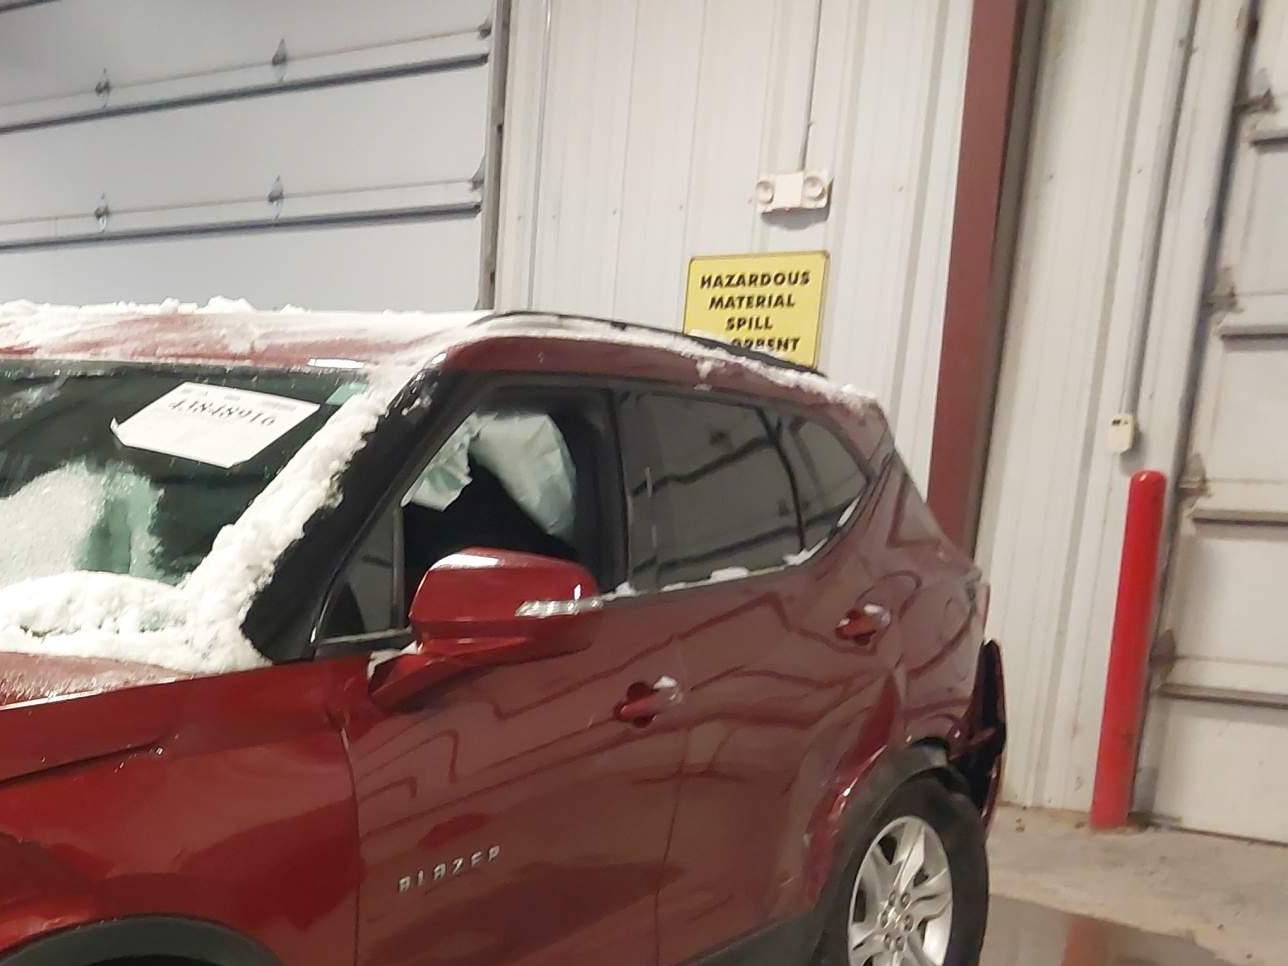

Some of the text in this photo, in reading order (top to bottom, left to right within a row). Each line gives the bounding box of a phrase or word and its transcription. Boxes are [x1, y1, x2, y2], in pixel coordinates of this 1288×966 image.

[700, 271, 811, 289] HAZARDOUS
[708, 294, 796, 311] MATERIAL
[725, 316, 774, 331] SPILL
[397, 845, 500, 894] BLAZER
